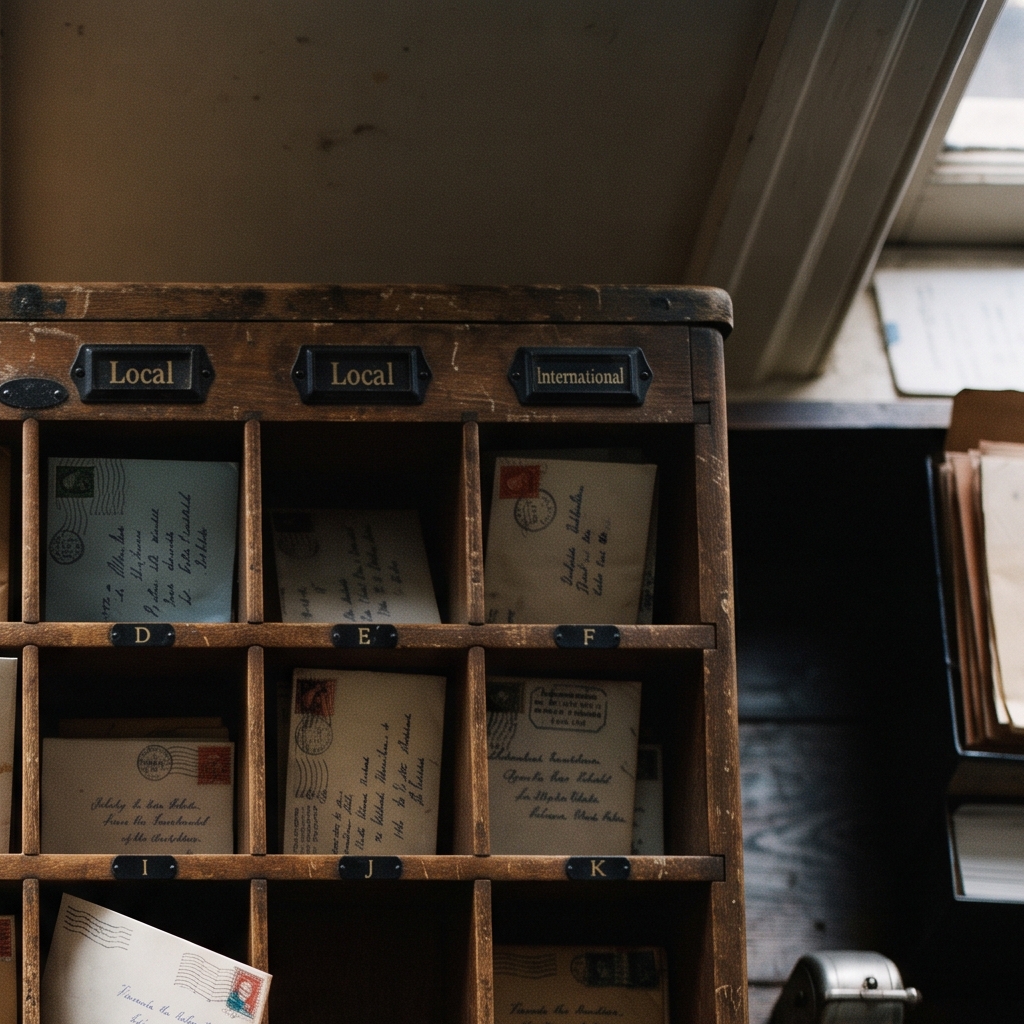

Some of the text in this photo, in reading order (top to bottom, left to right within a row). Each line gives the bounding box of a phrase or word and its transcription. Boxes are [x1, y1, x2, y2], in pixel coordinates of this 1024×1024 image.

[109, 360, 175, 385] Local
[330, 361, 395, 386] Local
[537, 366, 625, 385] International
[134, 626, 151, 644] D
[357, 627, 371, 645] E
[583, 628, 596, 646] F
[142, 859, 148, 876] I
[364, 859, 374, 878] J
[590, 859, 607, 877] K
